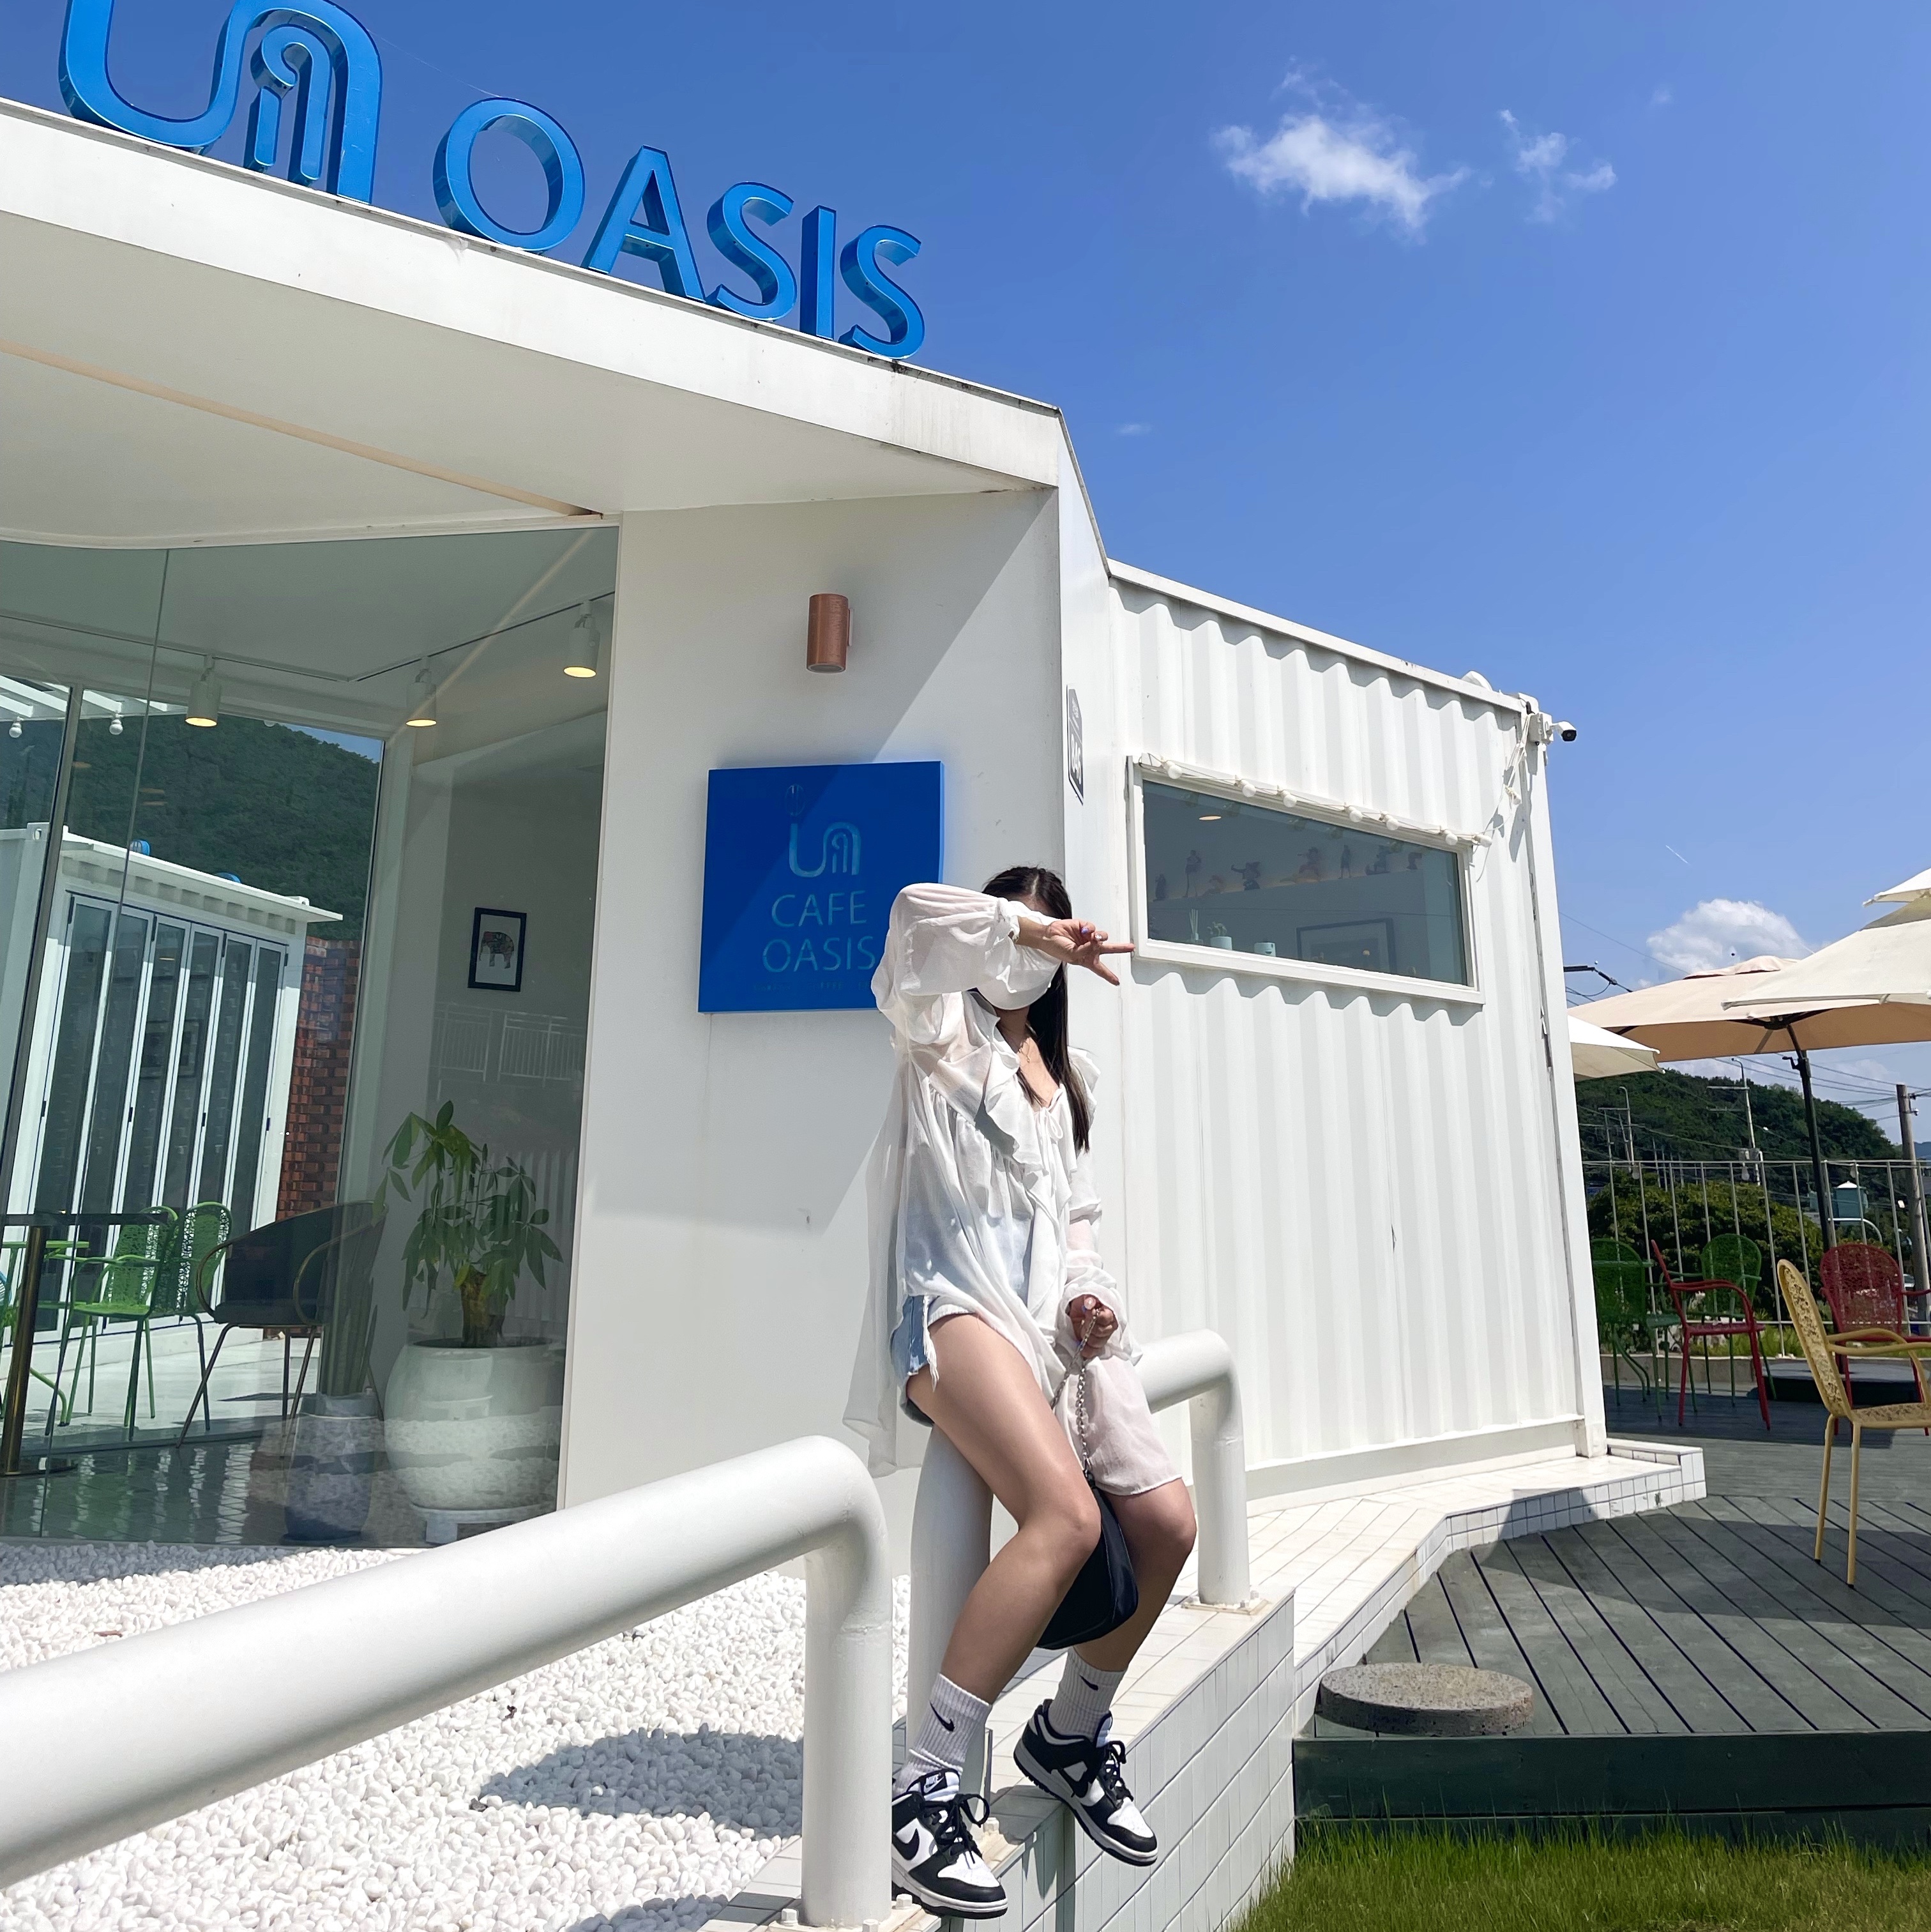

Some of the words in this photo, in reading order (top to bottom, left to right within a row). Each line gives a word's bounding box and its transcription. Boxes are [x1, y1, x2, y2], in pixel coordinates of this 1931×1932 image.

[432, 97, 925, 359] OASIS
[771, 891, 867, 927] CAFE
[762, 936, 875, 972] OASIS
[926, 1774, 940, 1786] NIKE
